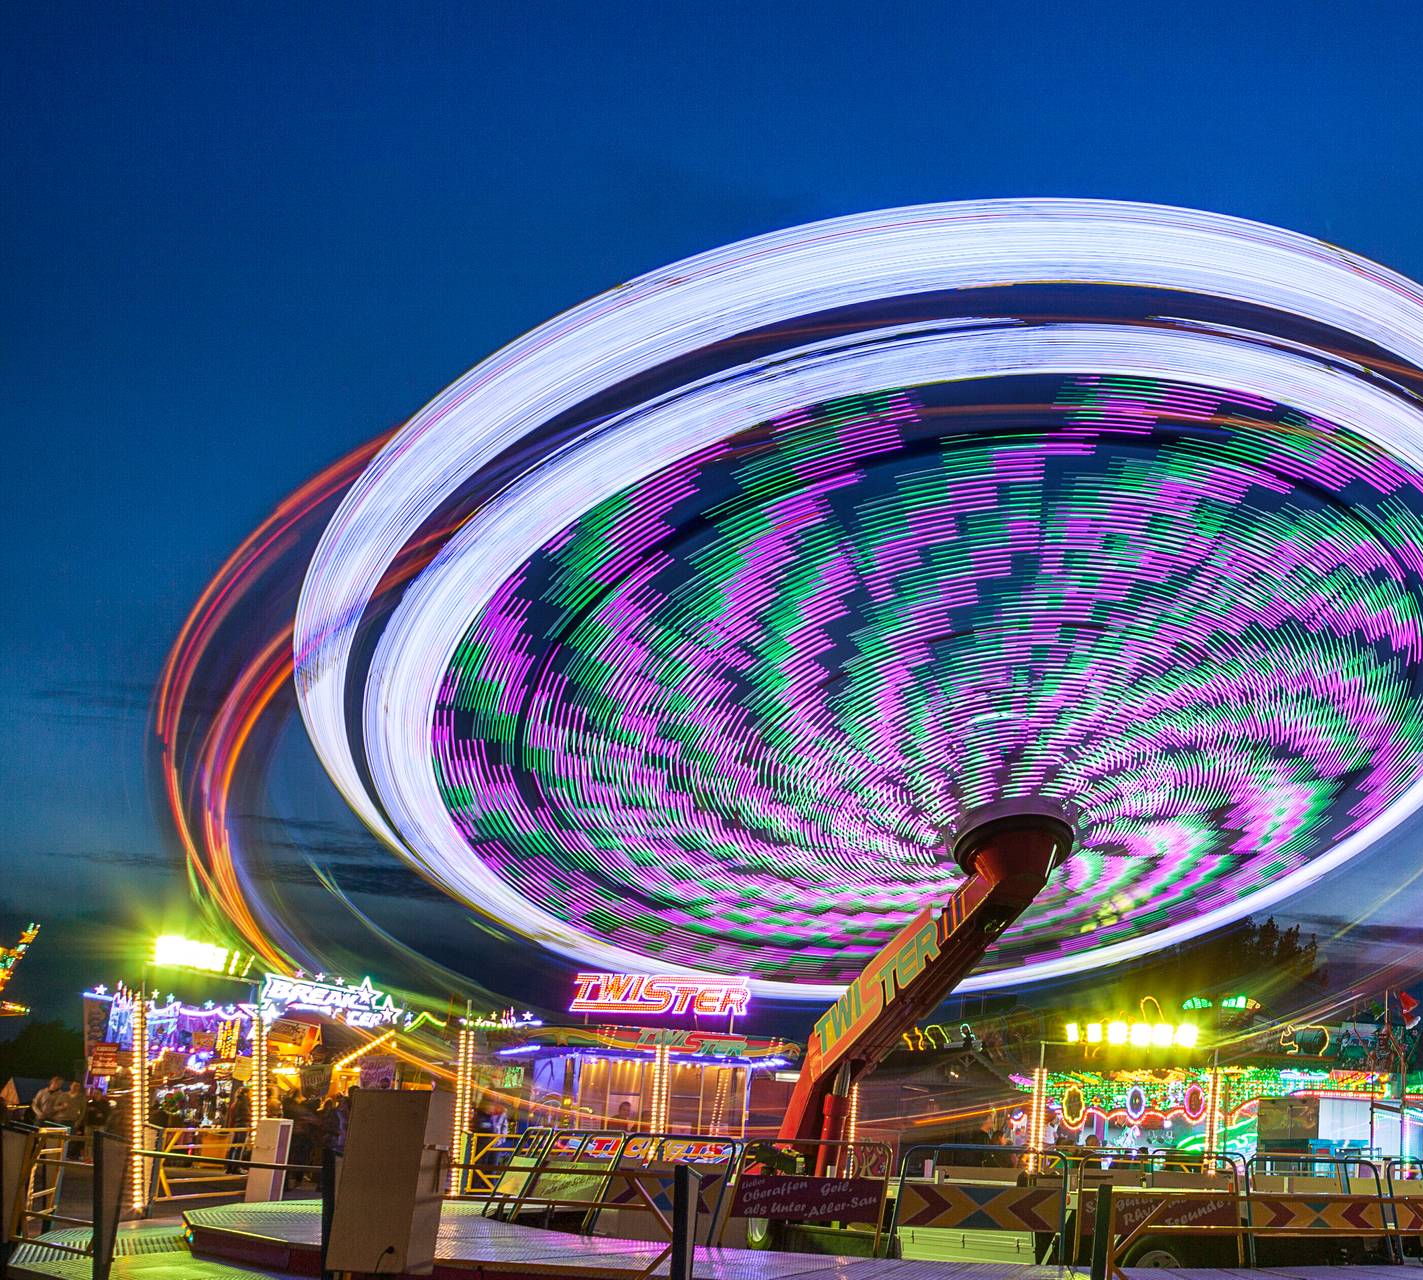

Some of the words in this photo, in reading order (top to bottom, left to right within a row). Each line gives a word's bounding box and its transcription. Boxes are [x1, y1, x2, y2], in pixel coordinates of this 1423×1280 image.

[569, 973, 751, 1016] TWISTER
[813, 905, 942, 1070] TWISTER
[633, 1028, 748, 1057] TWISTER
[742, 1181, 808, 1203] Oberaffen
[743, 1202, 768, 1216] als
